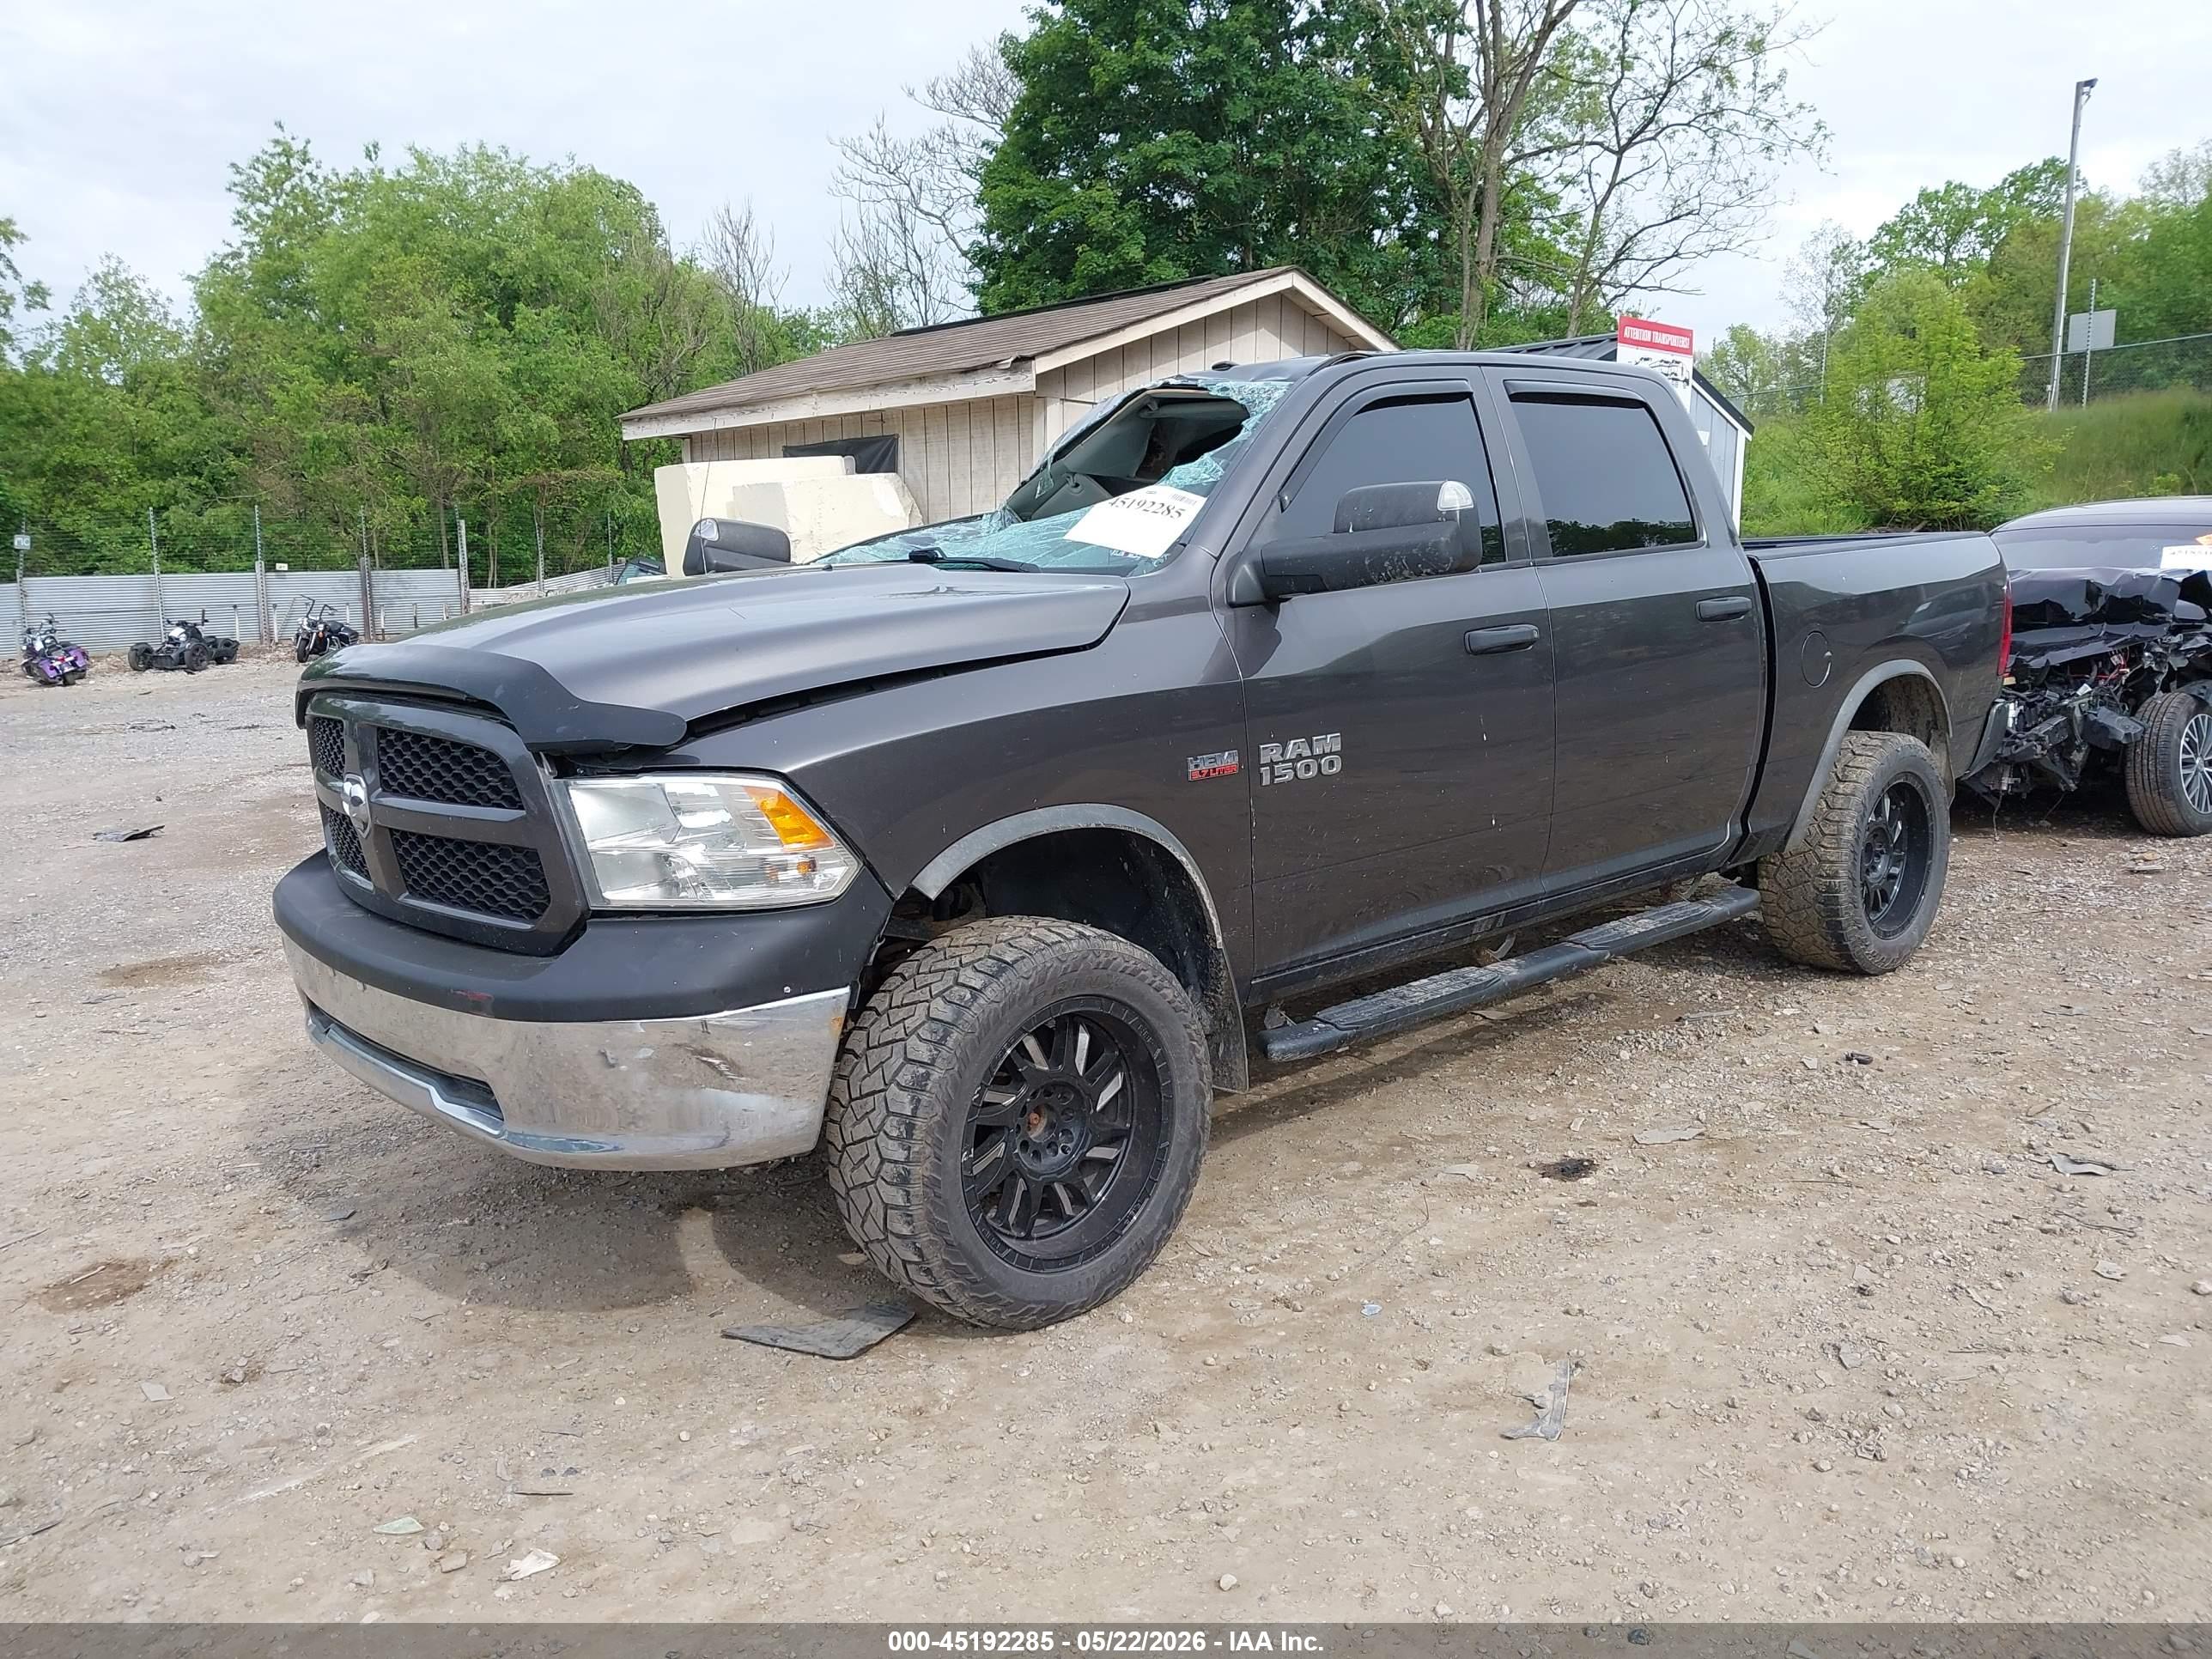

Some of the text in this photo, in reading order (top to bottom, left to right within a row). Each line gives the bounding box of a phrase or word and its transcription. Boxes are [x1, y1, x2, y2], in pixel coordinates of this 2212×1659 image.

[1623, 326, 1690, 349] ATTENTION TRANSPORTERS!
[1109, 497, 1186, 519] 45192285
[1259, 732, 1341, 764] RAM
[1187, 750, 1238, 770] HEMI
[1260, 755, 1342, 786] 1500
[1191, 764, 1237, 780] 5.7 LITER
